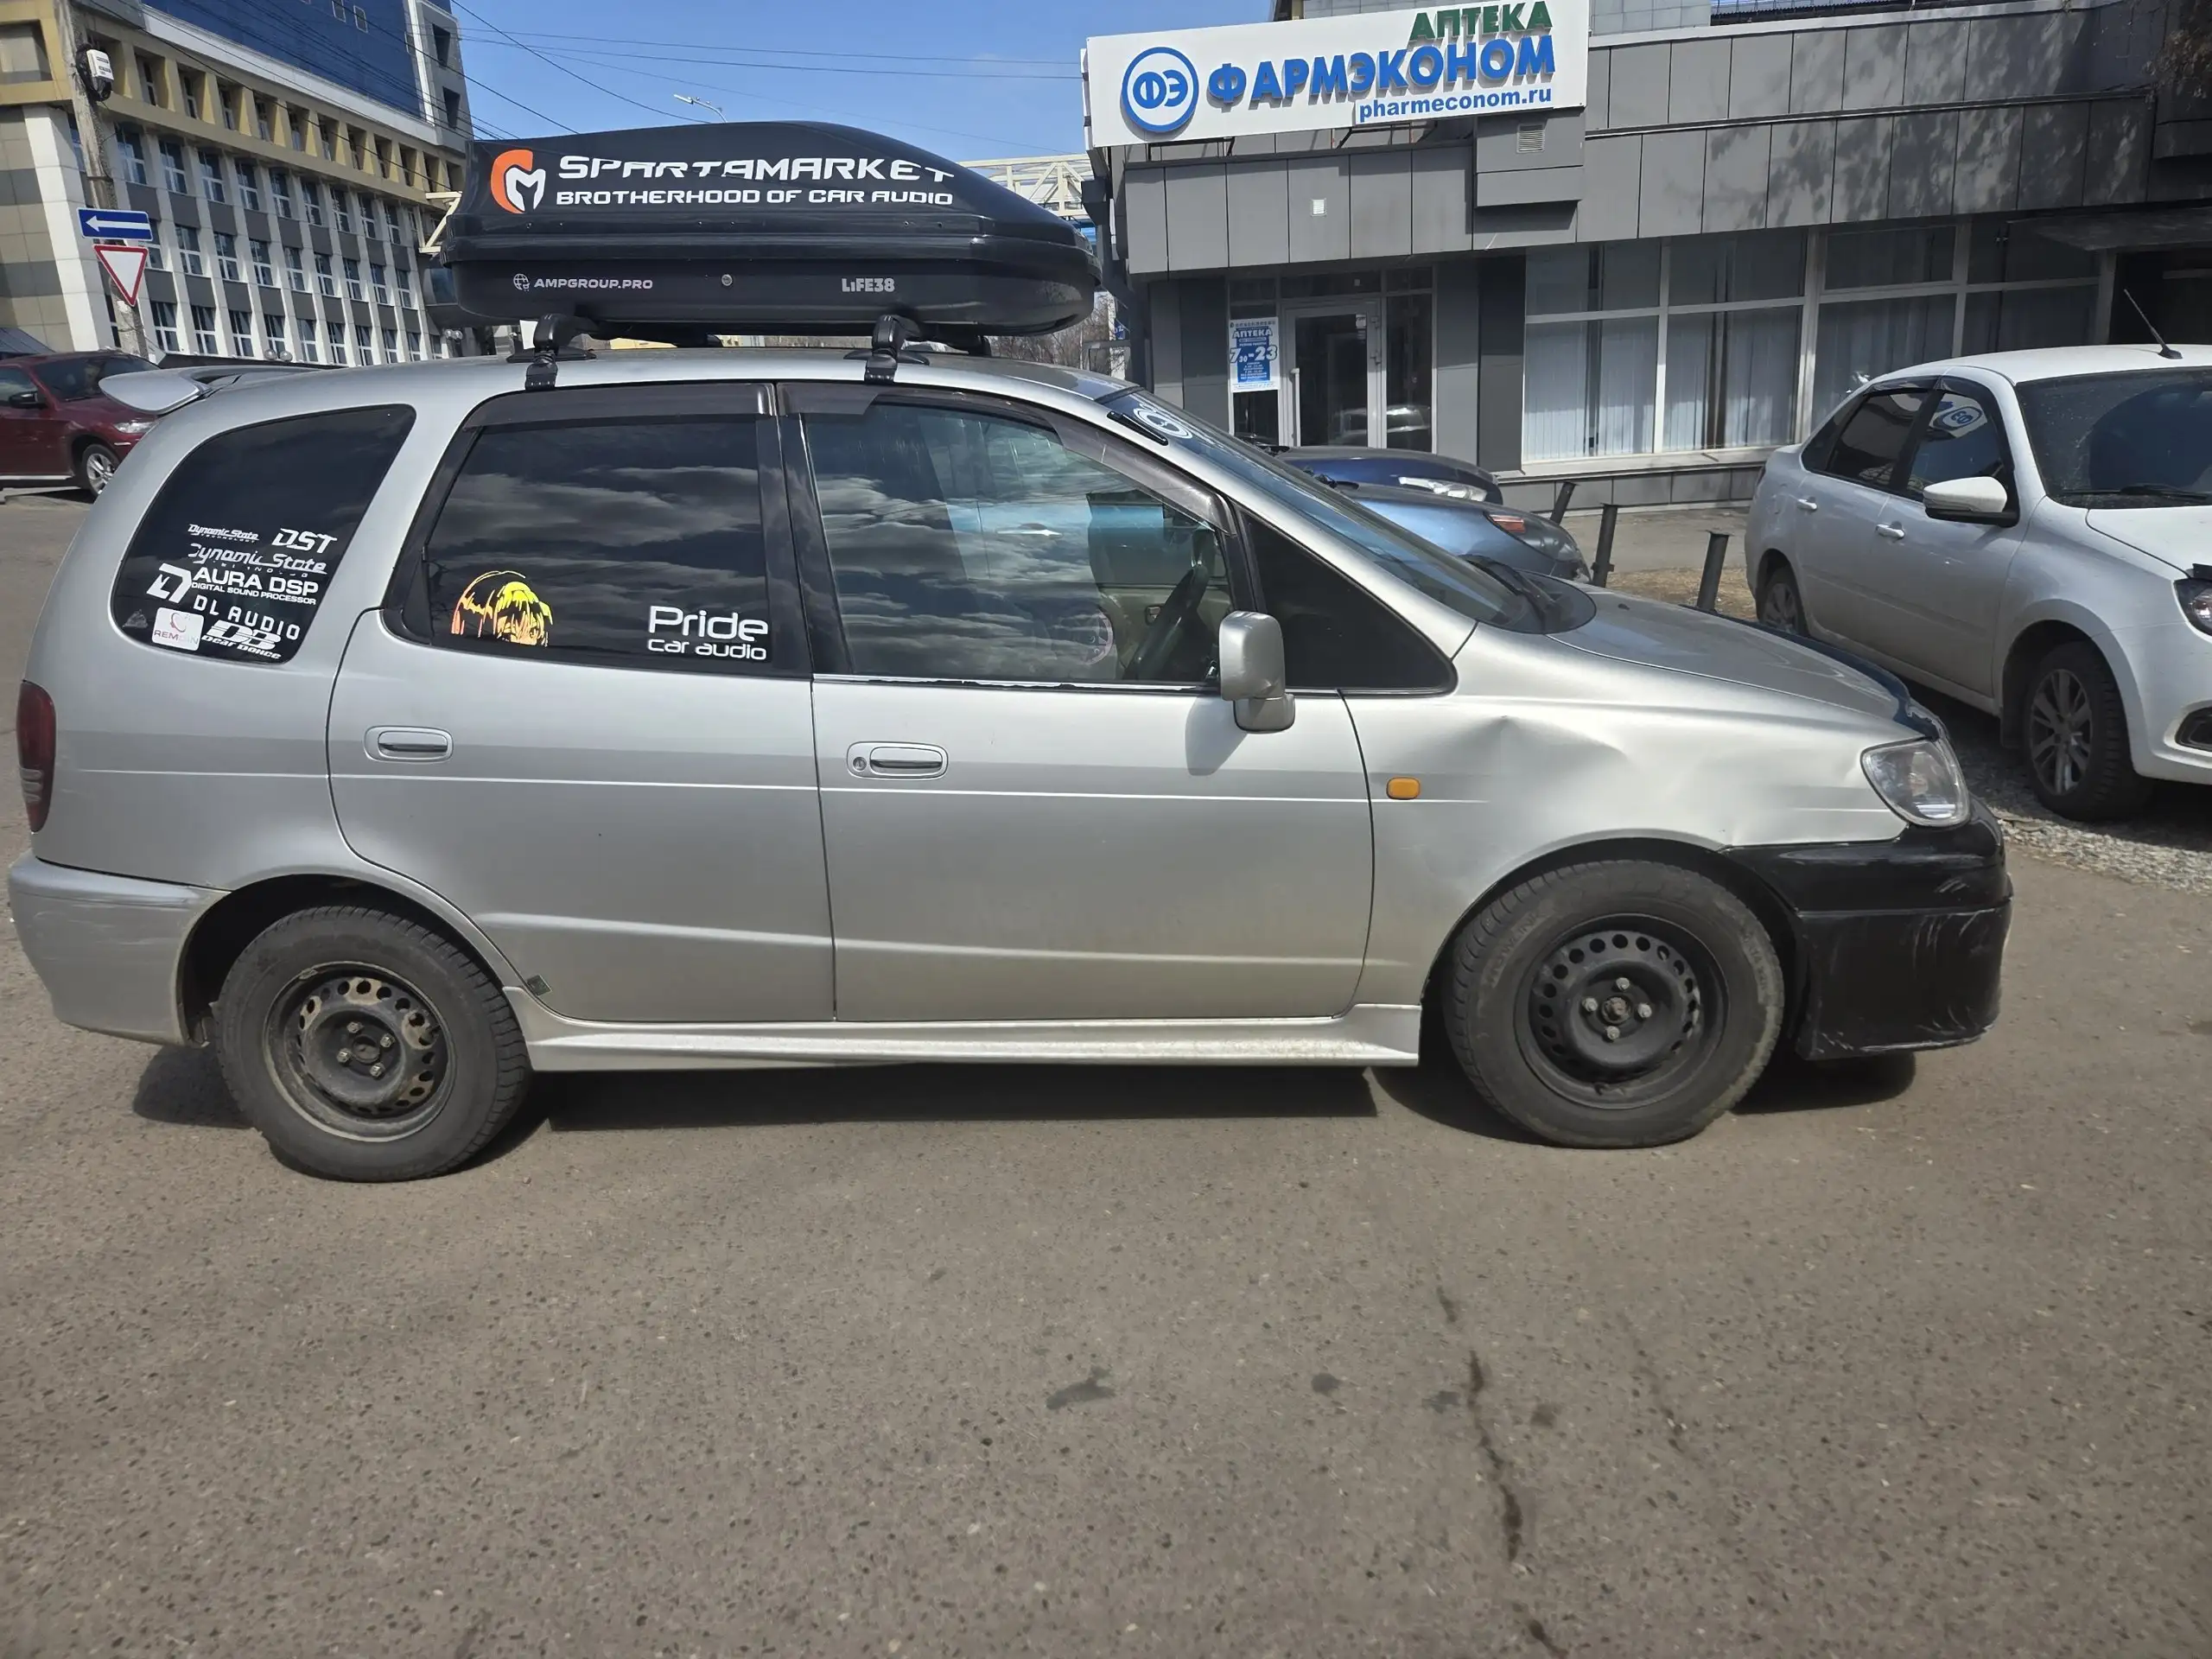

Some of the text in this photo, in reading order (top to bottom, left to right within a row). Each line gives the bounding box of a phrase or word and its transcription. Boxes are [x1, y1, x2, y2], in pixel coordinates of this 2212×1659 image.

[1412, 1, 1554, 41] АПТЕКА
[1209, 35, 1555, 103] ФАРМЭКОНОМ
[1359, 89, 1552, 123] pharmeconom.ru
[556, 189, 952, 205] BROTHERHOOD OF CAR AUDIO
[533, 277, 653, 290] AMPGROUP.PRO
[1232, 328, 1273, 338] АПТЕКА
[188, 524, 259, 540] Dynamic State
[271, 528, 337, 554] DST
[272, 553, 327, 575] State
[191, 582, 316, 605] DIGITAL SOUND PROCESSOR
[193, 567, 262, 589] AURA
[269, 576, 319, 596] DSP
[194, 594, 300, 640] DL AUDIO
[649, 605, 769, 641] Pride
[648, 639, 767, 660] car audio
